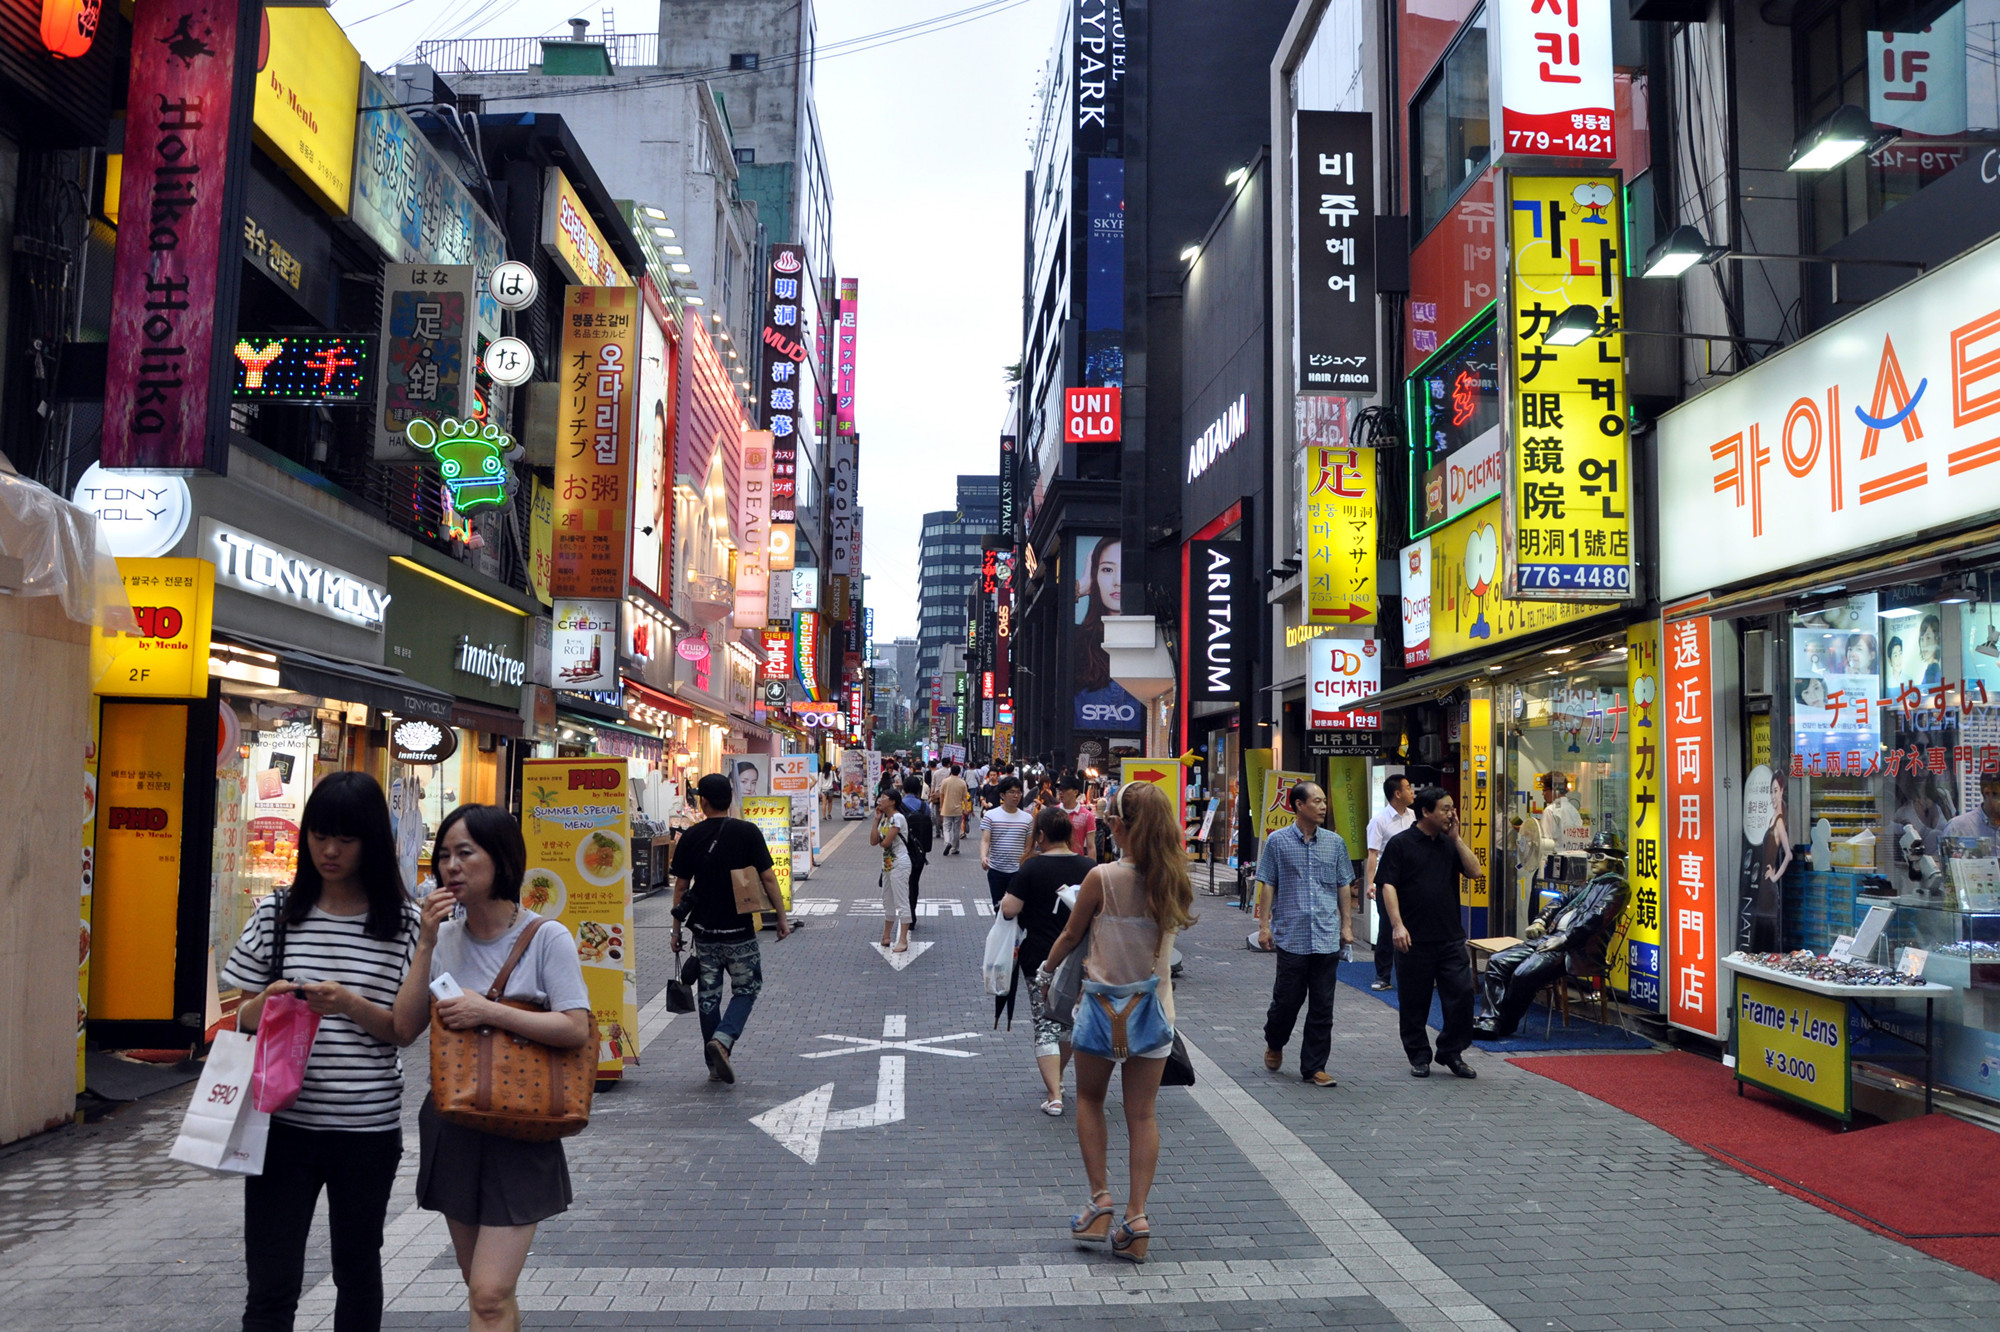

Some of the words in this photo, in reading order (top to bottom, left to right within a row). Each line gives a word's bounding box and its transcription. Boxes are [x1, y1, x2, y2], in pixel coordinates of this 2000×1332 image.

[271, 70, 285, 100] by
[286, 88, 318, 135] Menlo
[1571, 114, 1611, 130] 명동점
[1509, 130, 1612, 153] 779-1421
[150, 92, 204, 252] Holika
[560, 194, 587, 262] 오다리집
[1318, 151, 1360, 303] 비쥬헤어
[244, 215, 267, 257] 국수
[269, 239, 302, 290] 전문점
[411, 269, 448, 285] はな
[499, 271, 523, 297] は
[574, 292, 590, 304] 3F
[774, 278, 798, 327] 明洞
[573, 329, 626, 339] 名品生カルビ
[762, 326, 807, 363] MUD
[130, 271, 191, 435] Holika
[495, 348, 521, 370] な
[840, 311, 857, 409] 足マッサージ
[1308, 354, 1367, 367] ビジュヘア
[1308, 373, 1332, 382] HAIR
[1339, 372, 1370, 384] SALON
[568, 350, 593, 459] オダリチブ
[593, 342, 624, 465] 오다리집
[769, 361, 796, 437] 汗蒸幕
[1070, 394, 1111, 413] UNI
[1519, 301, 1566, 520] カナ眼鏡院
[839, 421, 852, 431] 5F
[1070, 416, 1114, 436] QLO
[1187, 393, 1248, 484] ARITAUM
[1310, 448, 1368, 498] 足
[84, 488, 168, 500] TONY
[561, 473, 619, 502] お粥
[834, 457, 852, 561] Cookie
[1003, 480, 1011, 536] SKYPARK
[1308, 502, 1338, 518] 명동
[1343, 505, 1373, 519] 明洞
[561, 513, 578, 527] 2F
[742, 479, 763, 577] BEAUTÉ
[1518, 529, 1628, 558] 明洞1號店
[1312, 521, 1332, 592] 마사지
[131, 576, 160, 587] 쌀국수
[165, 576, 193, 588] 전문점
[217, 533, 392, 623] TONYMOLY
[1518, 567, 1630, 588] 776-4480
[1311, 591, 1371, 603] 755-4480
[1892, 587, 1926, 601] ACUVUE
[557, 620, 612, 630] CREDIT
[999, 605, 1009, 637] SPAO
[1206, 548, 1231, 692] ARITAUM
[138, 640, 151, 651] by
[154, 640, 188, 650] Menlo
[765, 639, 788, 674] 부동산
[1630, 640, 1657, 668] 가나
[459, 634, 526, 689] innisfree
[129, 668, 151, 682] 2F
[1314, 680, 1377, 698] 디디치킨
[403, 695, 447, 714] TONYMOLY
[1081, 703, 1136, 722] SPAO
[1824, 677, 1988, 729] チョーやすい
[1314, 719, 1345, 728] 방문포장시
[1346, 711, 1378, 728] 1만원
[1586, 692, 1628, 745] カナ
[1314, 733, 1374, 746] 비쥬헤어
[398, 751, 438, 761] innisfree
[1312, 748, 1330, 756] Bijou
[111, 770, 136, 779] 베트남
[138, 770, 162, 779] 쌀국수
[567, 768, 621, 791] PHO
[786, 762, 805, 774] 2F
[146, 781, 171, 791] 전문점
[108, 806, 168, 831] PHO
[534, 806, 580, 817] SUMMER
[582, 805, 624, 816] SPECIAL
[743, 806, 786, 816] オダリチブ
[1673, 621, 1705, 1014] 遠近両用専門店
[563, 820, 595, 830] MENU
[1634, 736, 1658, 930] カナ眼鏡
[1629, 977, 1659, 1004] 썬그라스
[1741, 993, 1786, 1031] Frame
[1802, 1008, 1839, 1048] Lens
[207, 1083, 239, 1106] SPAO
